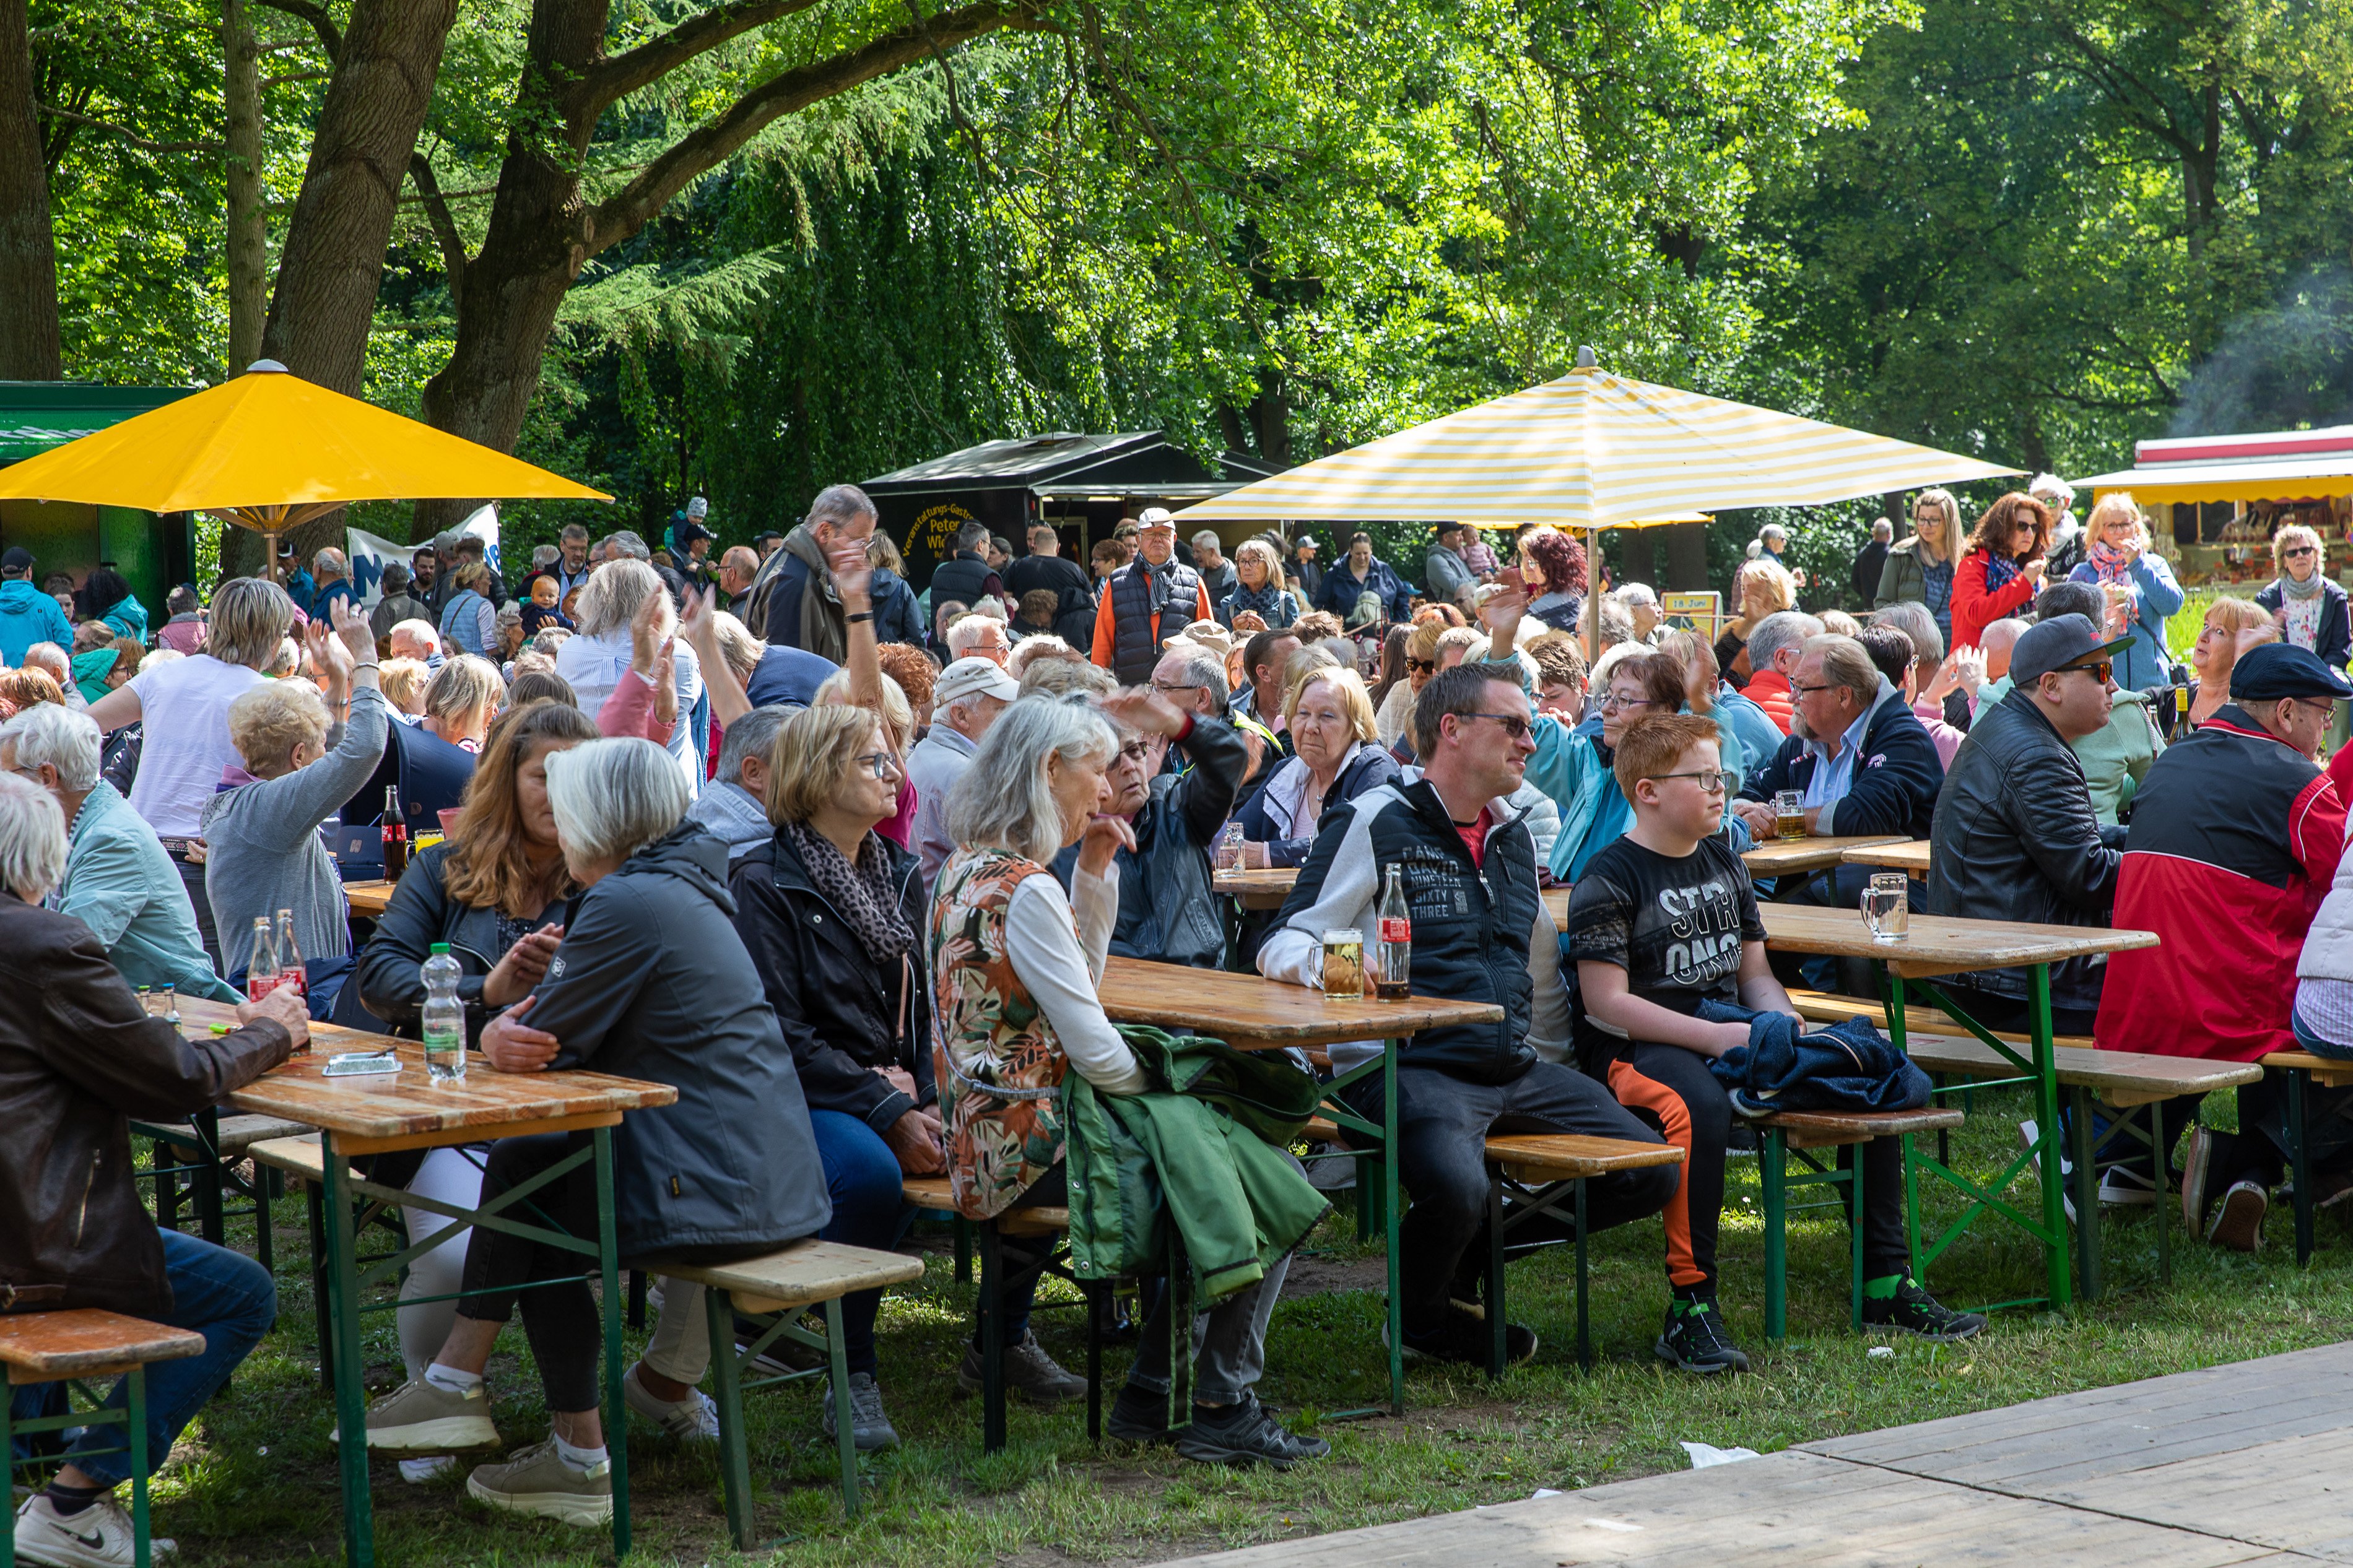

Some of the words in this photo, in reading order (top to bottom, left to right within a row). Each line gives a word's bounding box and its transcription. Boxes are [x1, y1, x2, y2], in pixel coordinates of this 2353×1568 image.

[930, 519, 960, 532] Peter
[1402, 846, 1445, 861] CAMP
[1407, 860, 1459, 876] DAVID
[1411, 875, 1461, 888] NINETEEN
[1416, 890, 1447, 903] SIXTY
[1412, 905, 1449, 919] THREE
